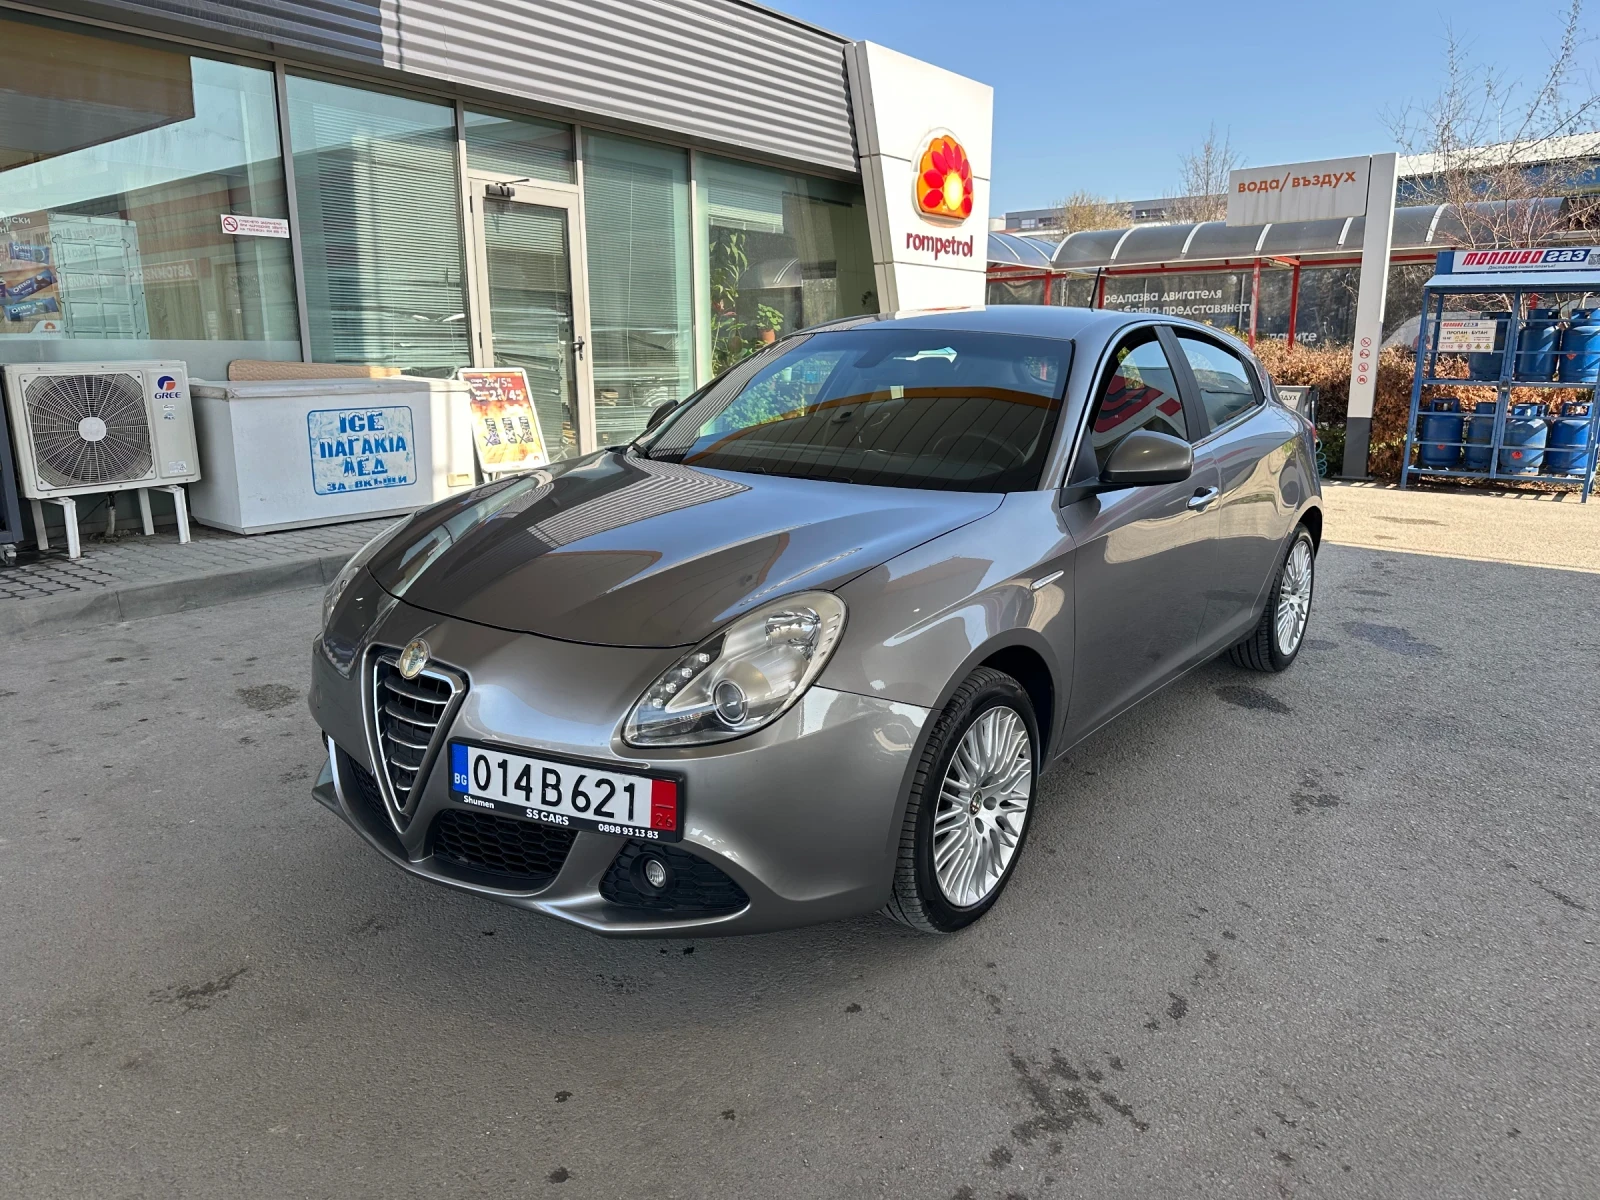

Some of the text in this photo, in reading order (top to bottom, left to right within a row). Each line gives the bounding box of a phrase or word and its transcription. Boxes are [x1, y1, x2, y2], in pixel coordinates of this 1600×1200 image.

[906, 232, 973, 260] rompetrol
[1103, 288, 1222, 305] редпазва двигателя
[154, 391, 181, 399] GREE
[339, 411, 384, 433] ICE
[327, 476, 407, 492] ЗА ВКЪЩИ
[454, 773, 467, 786] BG
[464, 795, 494, 809] Shumen
[526, 808, 569, 826] SS CARS
[598, 823, 659, 840] 0898 93 13 83
